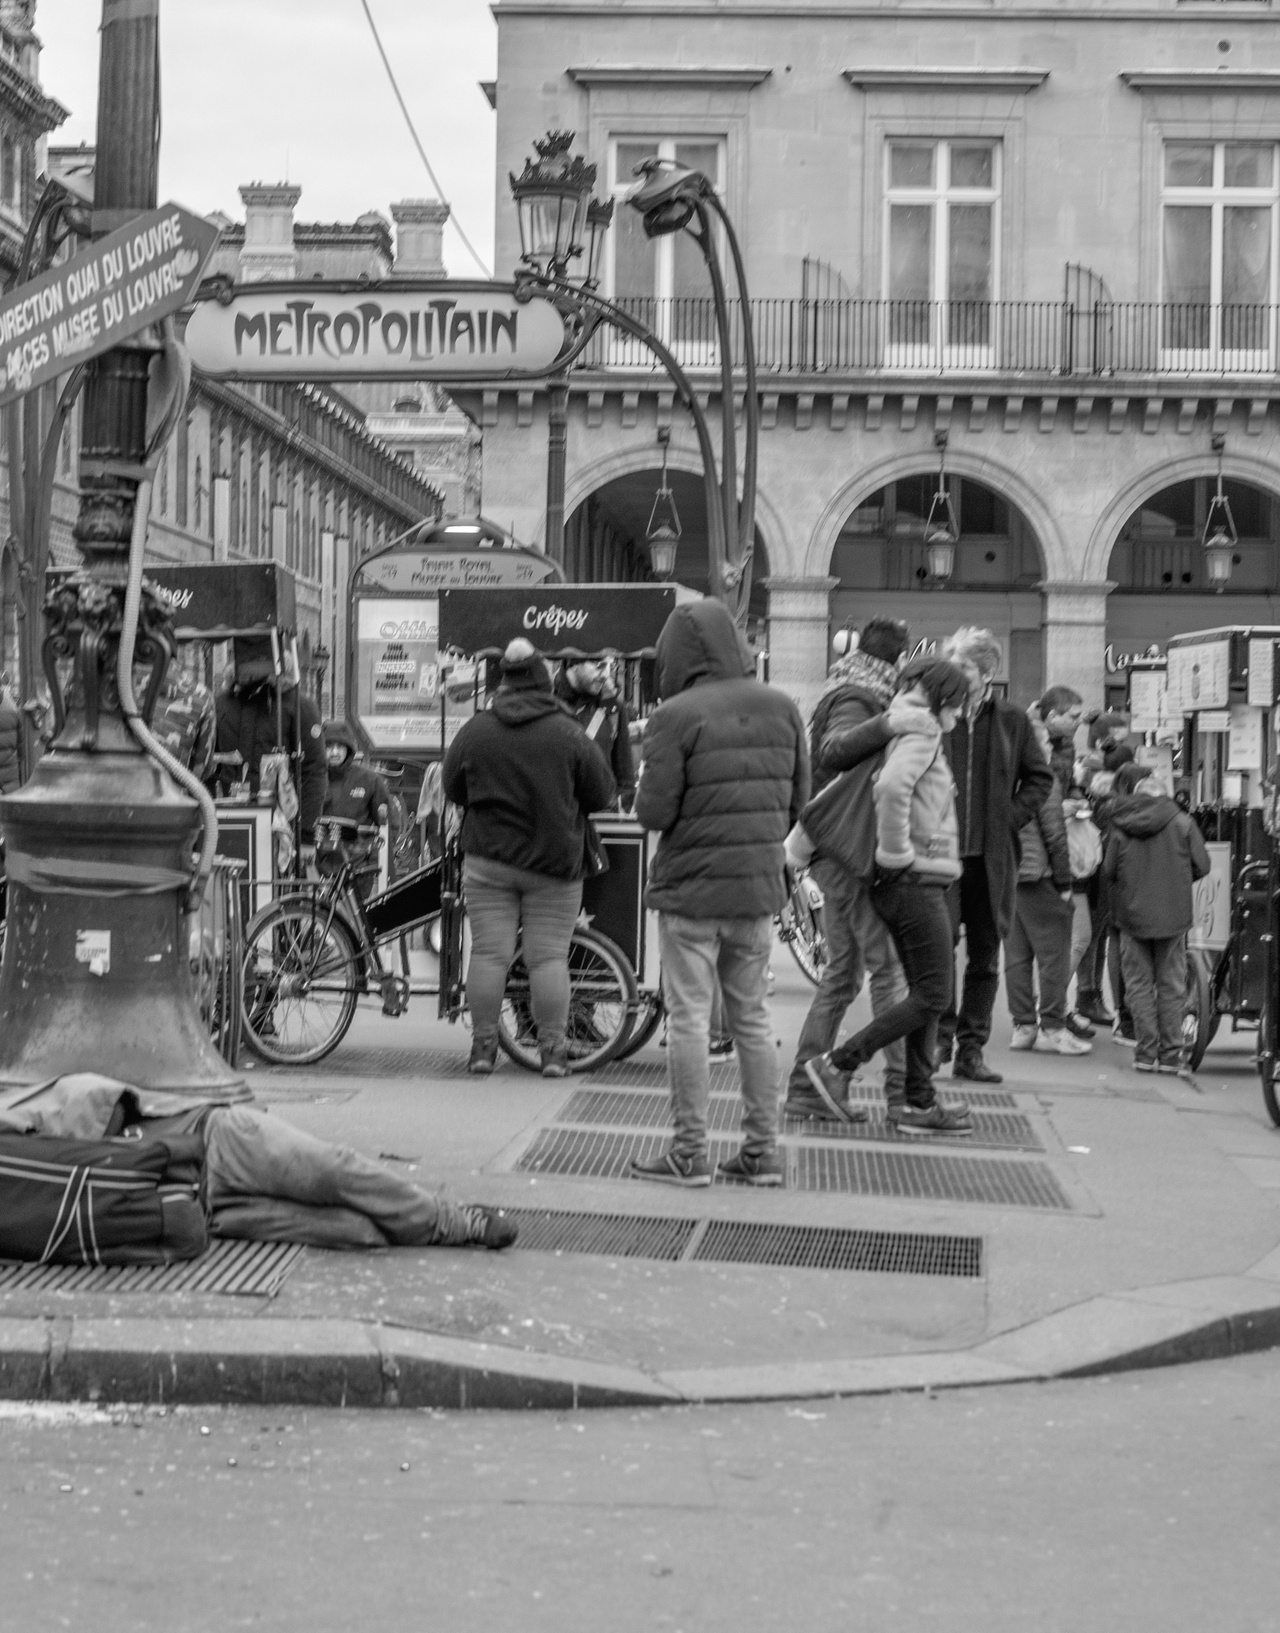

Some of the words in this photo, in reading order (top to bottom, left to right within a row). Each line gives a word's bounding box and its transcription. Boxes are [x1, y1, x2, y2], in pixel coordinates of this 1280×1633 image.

[67, 261, 100, 305] QUAI
[102, 247, 124, 285] DU
[126, 212, 183, 273] LOUVRE
[102, 288, 124, 330] DU
[234, 299, 518, 361] METROPOLITAIN
[523, 604, 589, 636] Crêpes
